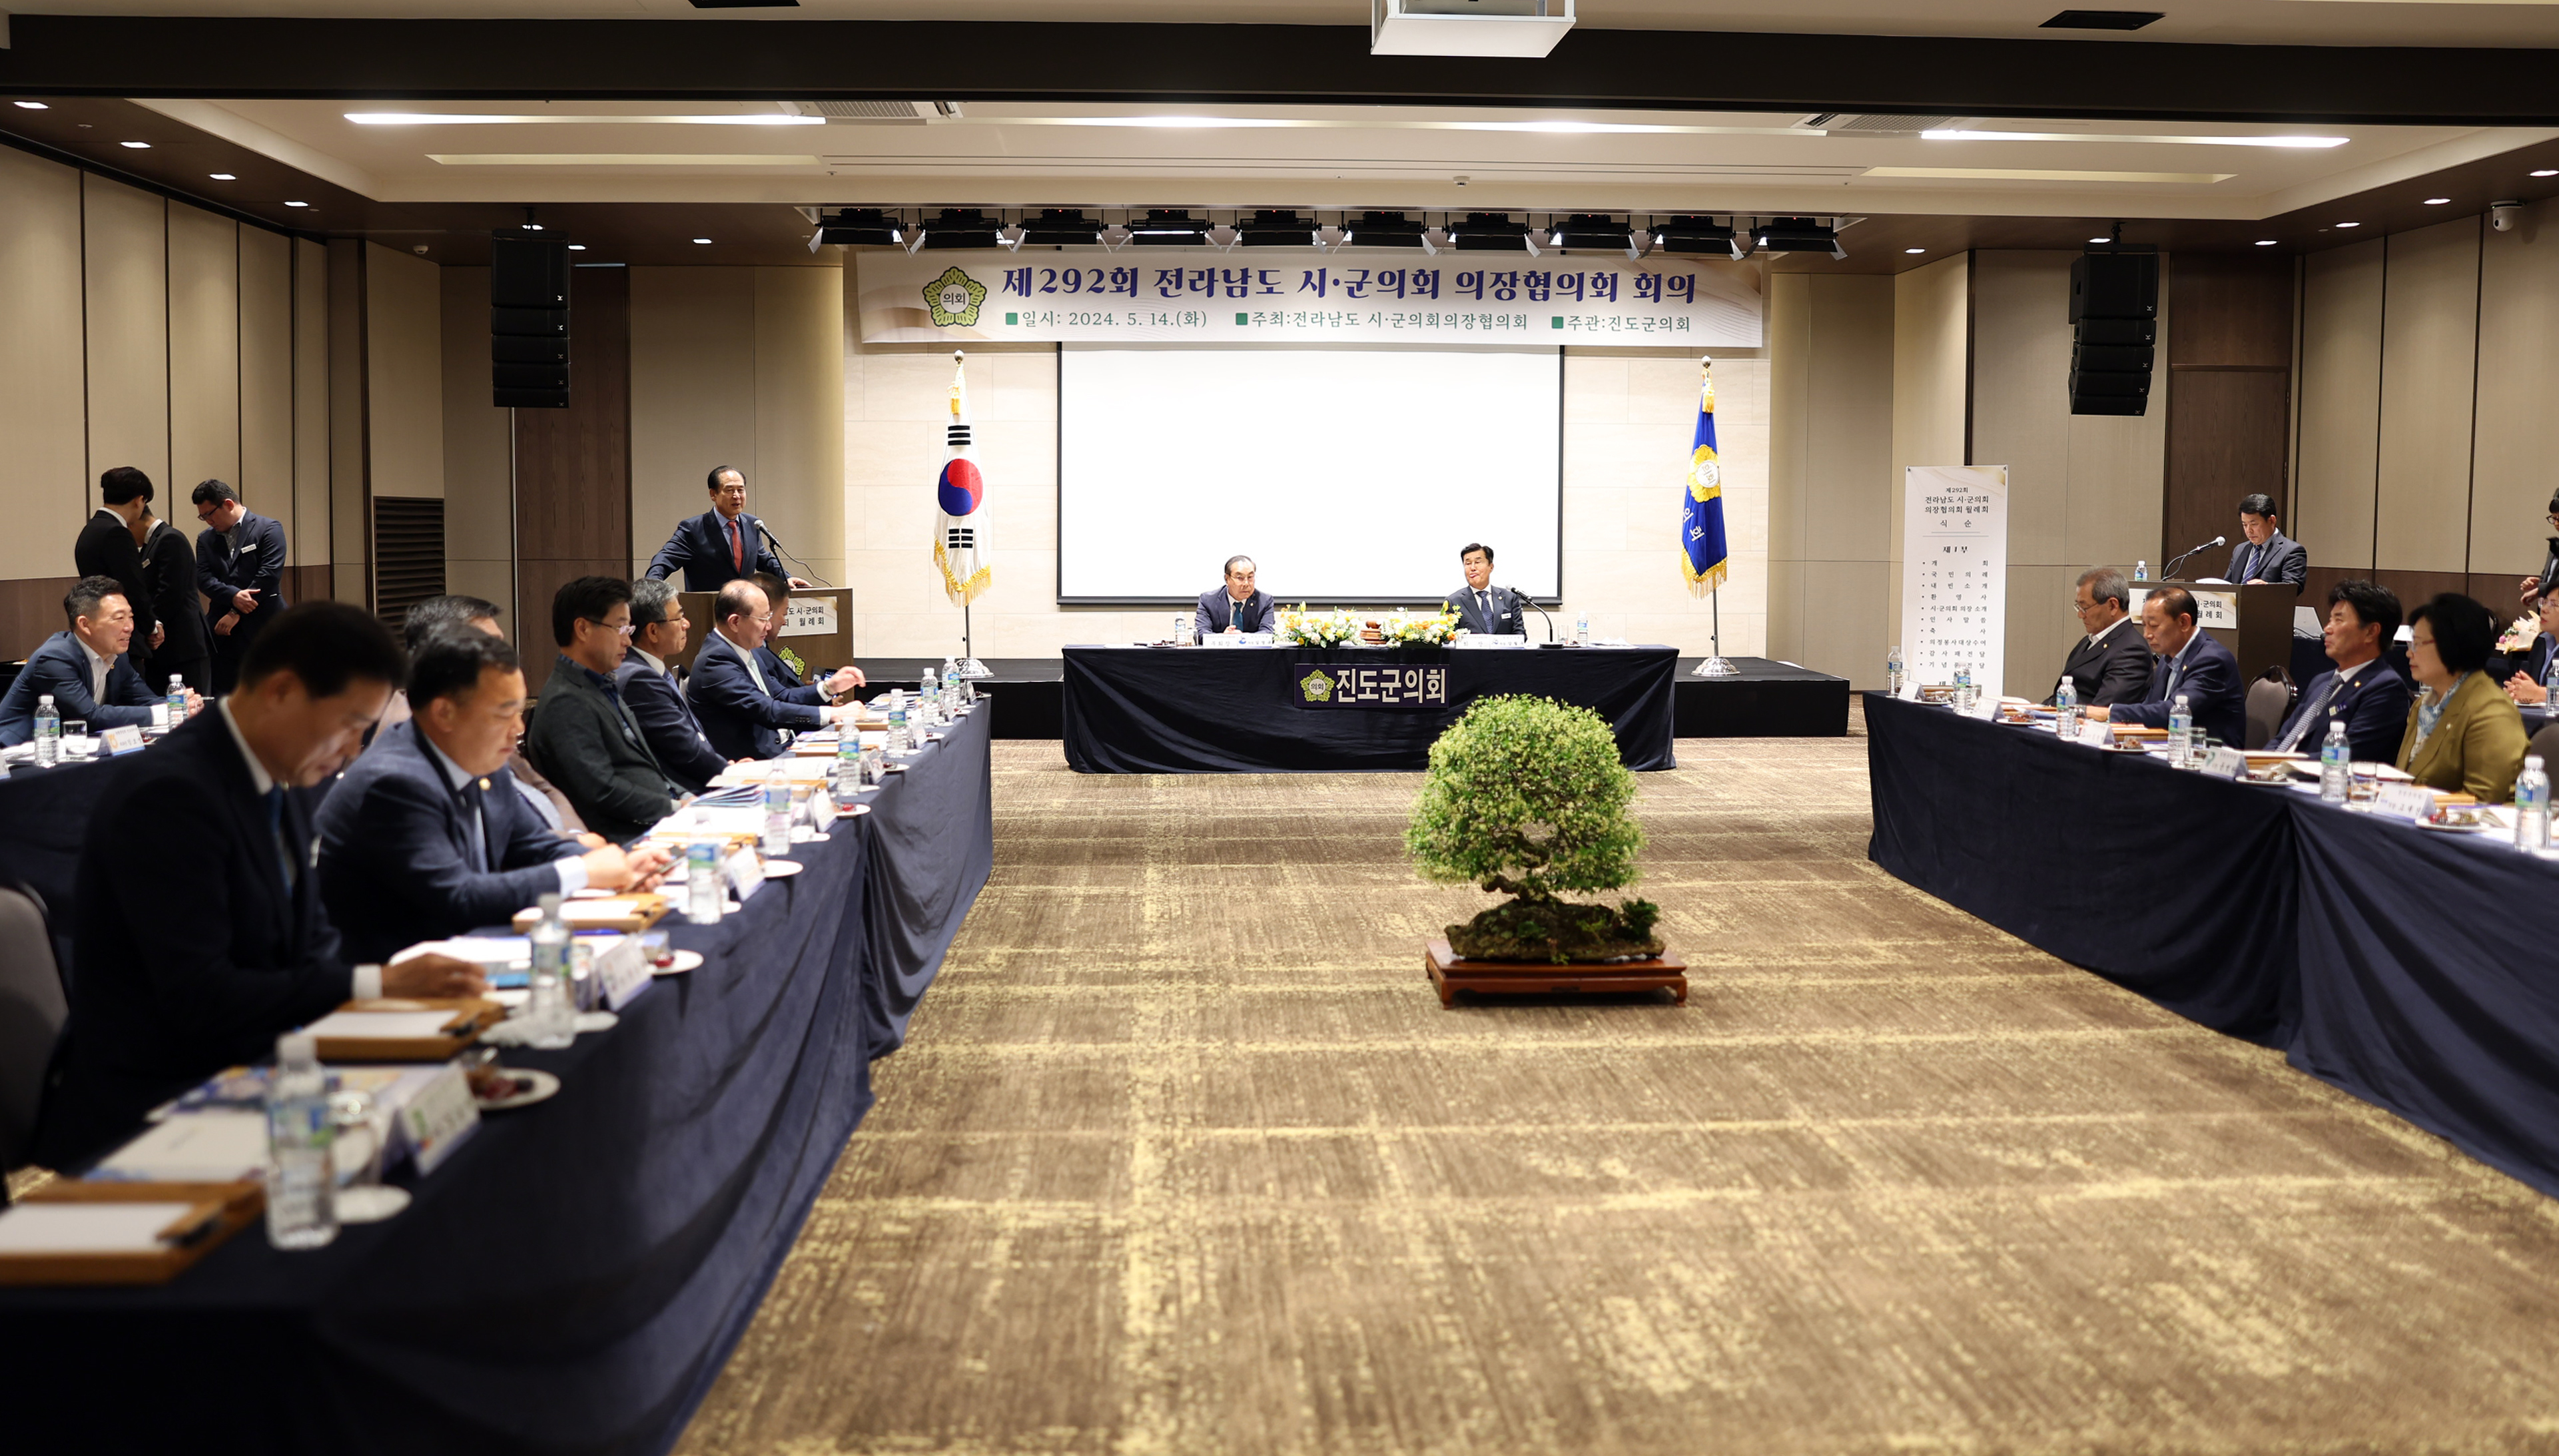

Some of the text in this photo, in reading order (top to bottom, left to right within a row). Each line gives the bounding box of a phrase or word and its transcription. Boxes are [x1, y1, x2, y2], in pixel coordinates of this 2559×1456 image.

[1002, 266, 1696, 304] 제292회 전라남도 시·군의회 의장협의회 회의
[942, 292, 966, 306] 의회
[1022, 310, 1690, 333] 일시: 2024. 5. 14.(화) 주최:전라남도 시·군의회의장협의회 주관:진도군의회
[797, 606, 824, 615] 시·군의회
[2197, 600, 2222, 609] ·군의회
[1335, 668, 1446, 703] 진도군의회
